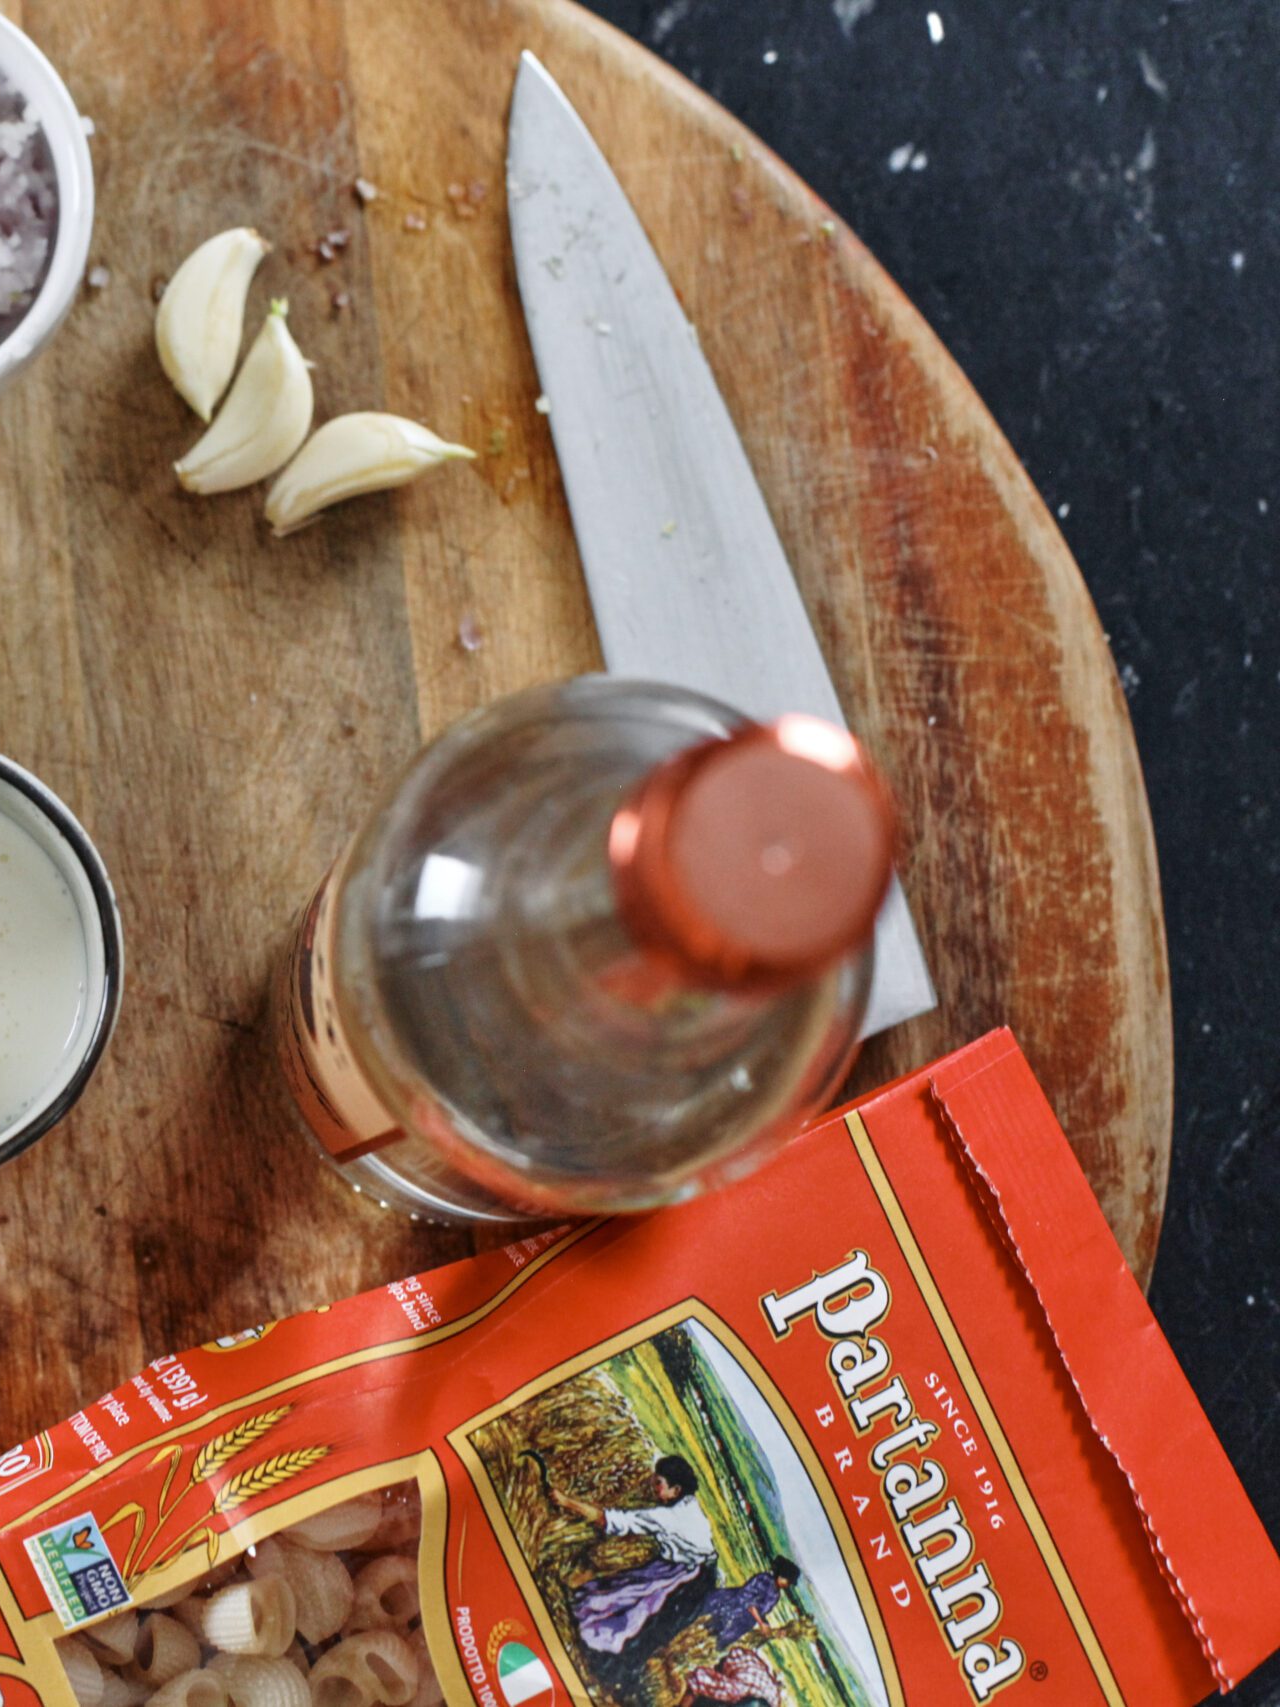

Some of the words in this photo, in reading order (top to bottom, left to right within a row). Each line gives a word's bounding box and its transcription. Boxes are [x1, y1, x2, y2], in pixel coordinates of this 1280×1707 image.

[401, 1300, 429, 1331] bind
[416, 1291, 442, 1324] since
[102, 1399, 130, 1427] place
[760, 1250, 1024, 1703] Partanna
[924, 1371, 977, 1457] SINCE
[973, 1464, 1006, 1531] 1916
[814, 1404, 912, 1609] BRAND
[43, 1537, 85, 1617] VERIFIED
[86, 1569, 111, 1608] GMO
[98, 1563, 123, 1602] NON
[456, 1606, 486, 1684] PRODOTTO
